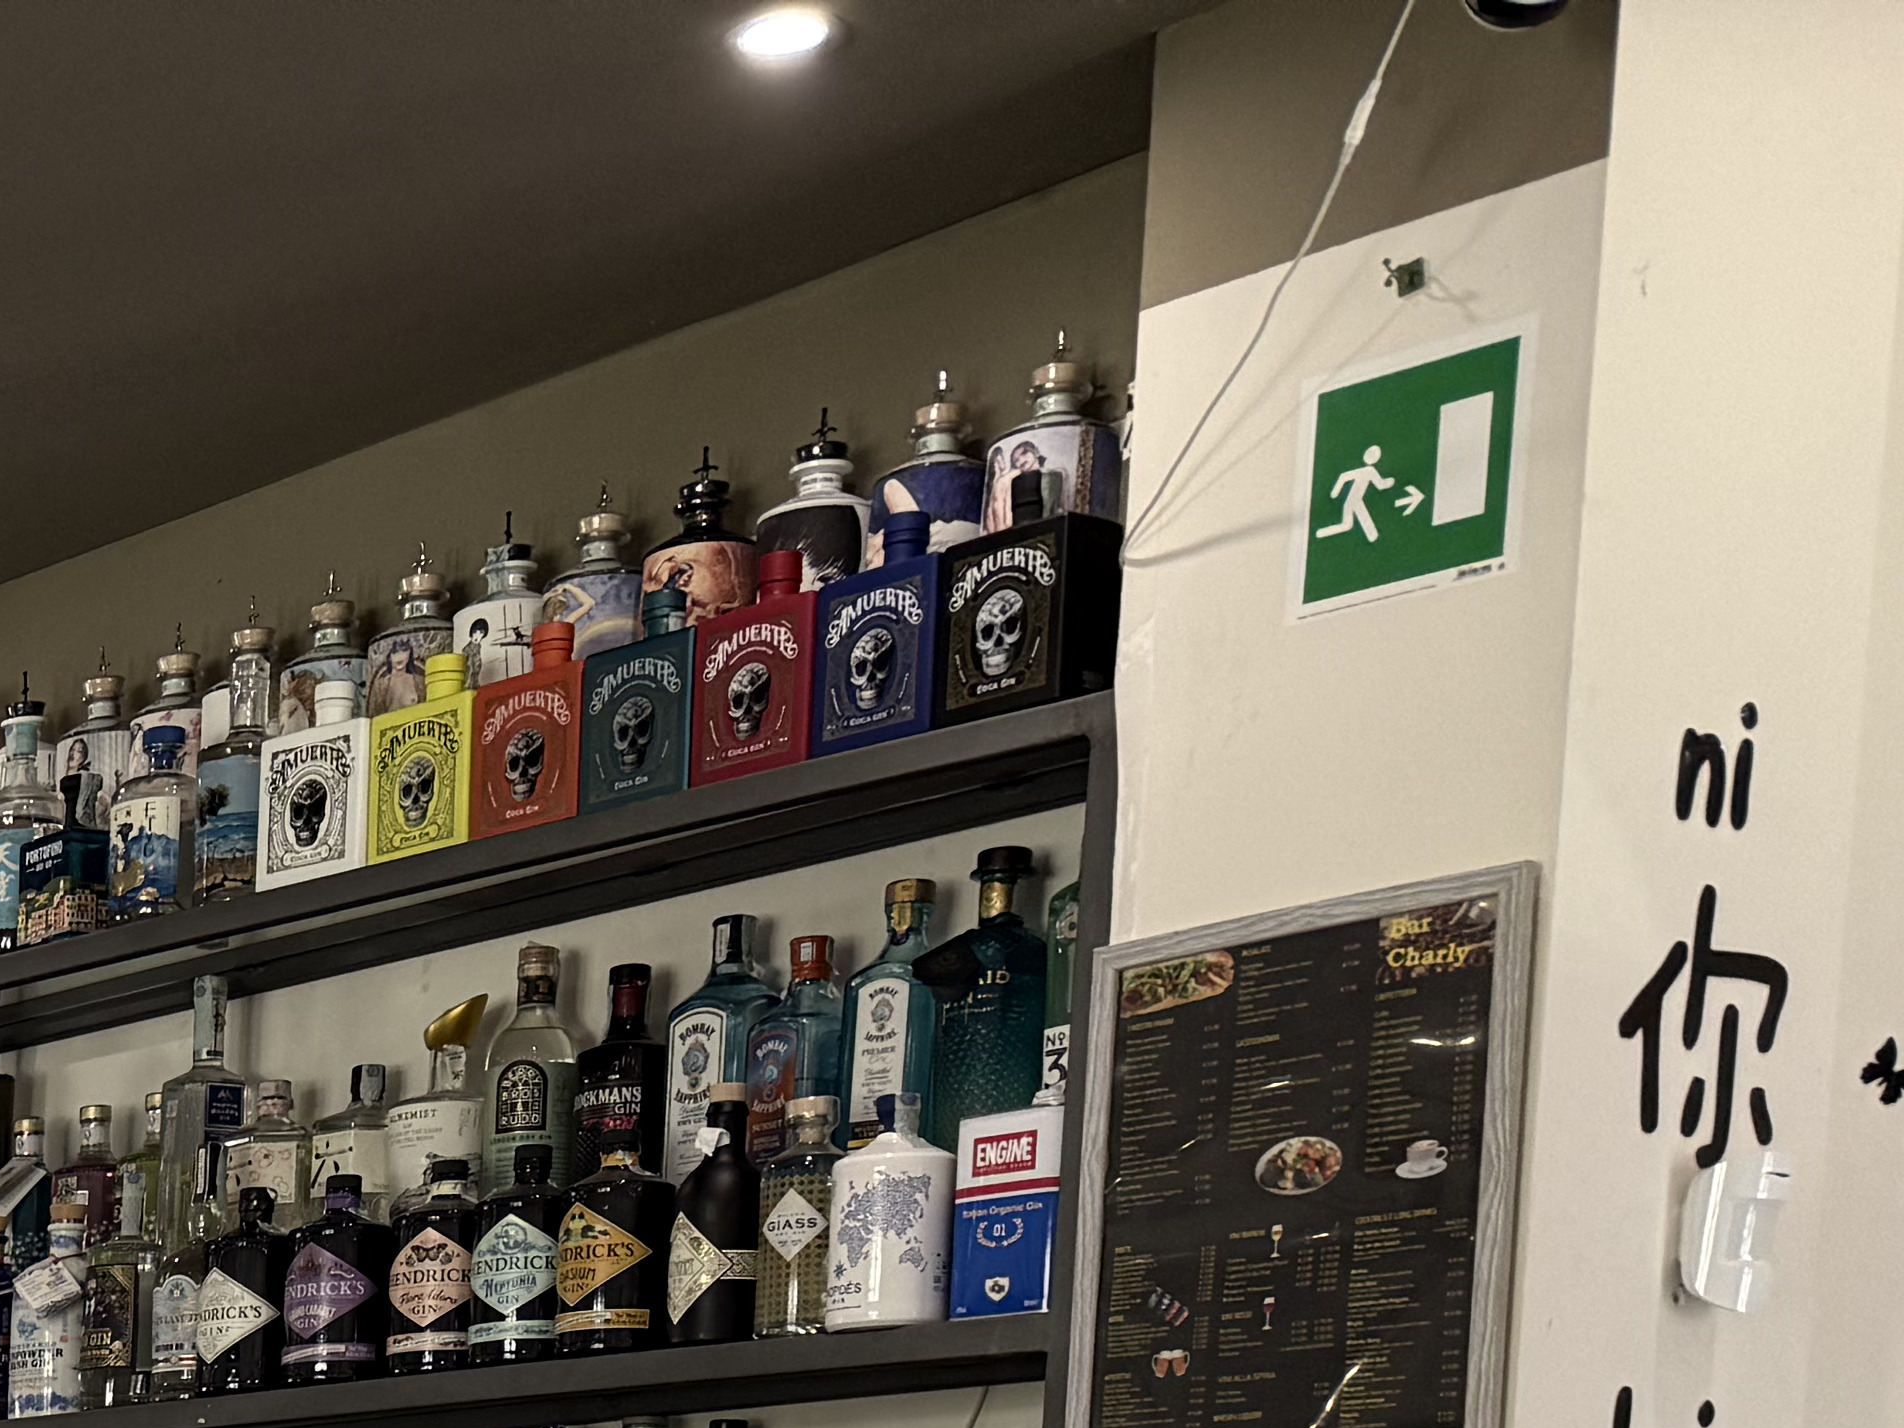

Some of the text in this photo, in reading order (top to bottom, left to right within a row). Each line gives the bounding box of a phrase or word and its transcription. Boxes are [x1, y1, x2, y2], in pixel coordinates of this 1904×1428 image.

[482, 689, 571, 745] AMUERTE
[378, 720, 459, 773] AMUERTE
[269, 743, 354, 795] AMUERTE
[1675, 701, 1758, 830] ni
[1390, 915, 1432, 937] Bar
[1386, 943, 1473, 969] Charly
[677, 1023, 717, 1043] BOMBAY
[1618, 884, 1789, 1169] 你
[755, 1040, 788, 1058] BOMBAY
[1045, 1048, 1068, 1089] 3
[613, 1102, 641, 1114] GIN
[976, 1133, 1032, 1168] ENGINE
[993, 1223, 1006, 1237] 01
[412, 1304, 438, 1315] GIN
[497, 1293, 520, 1305] GIN
